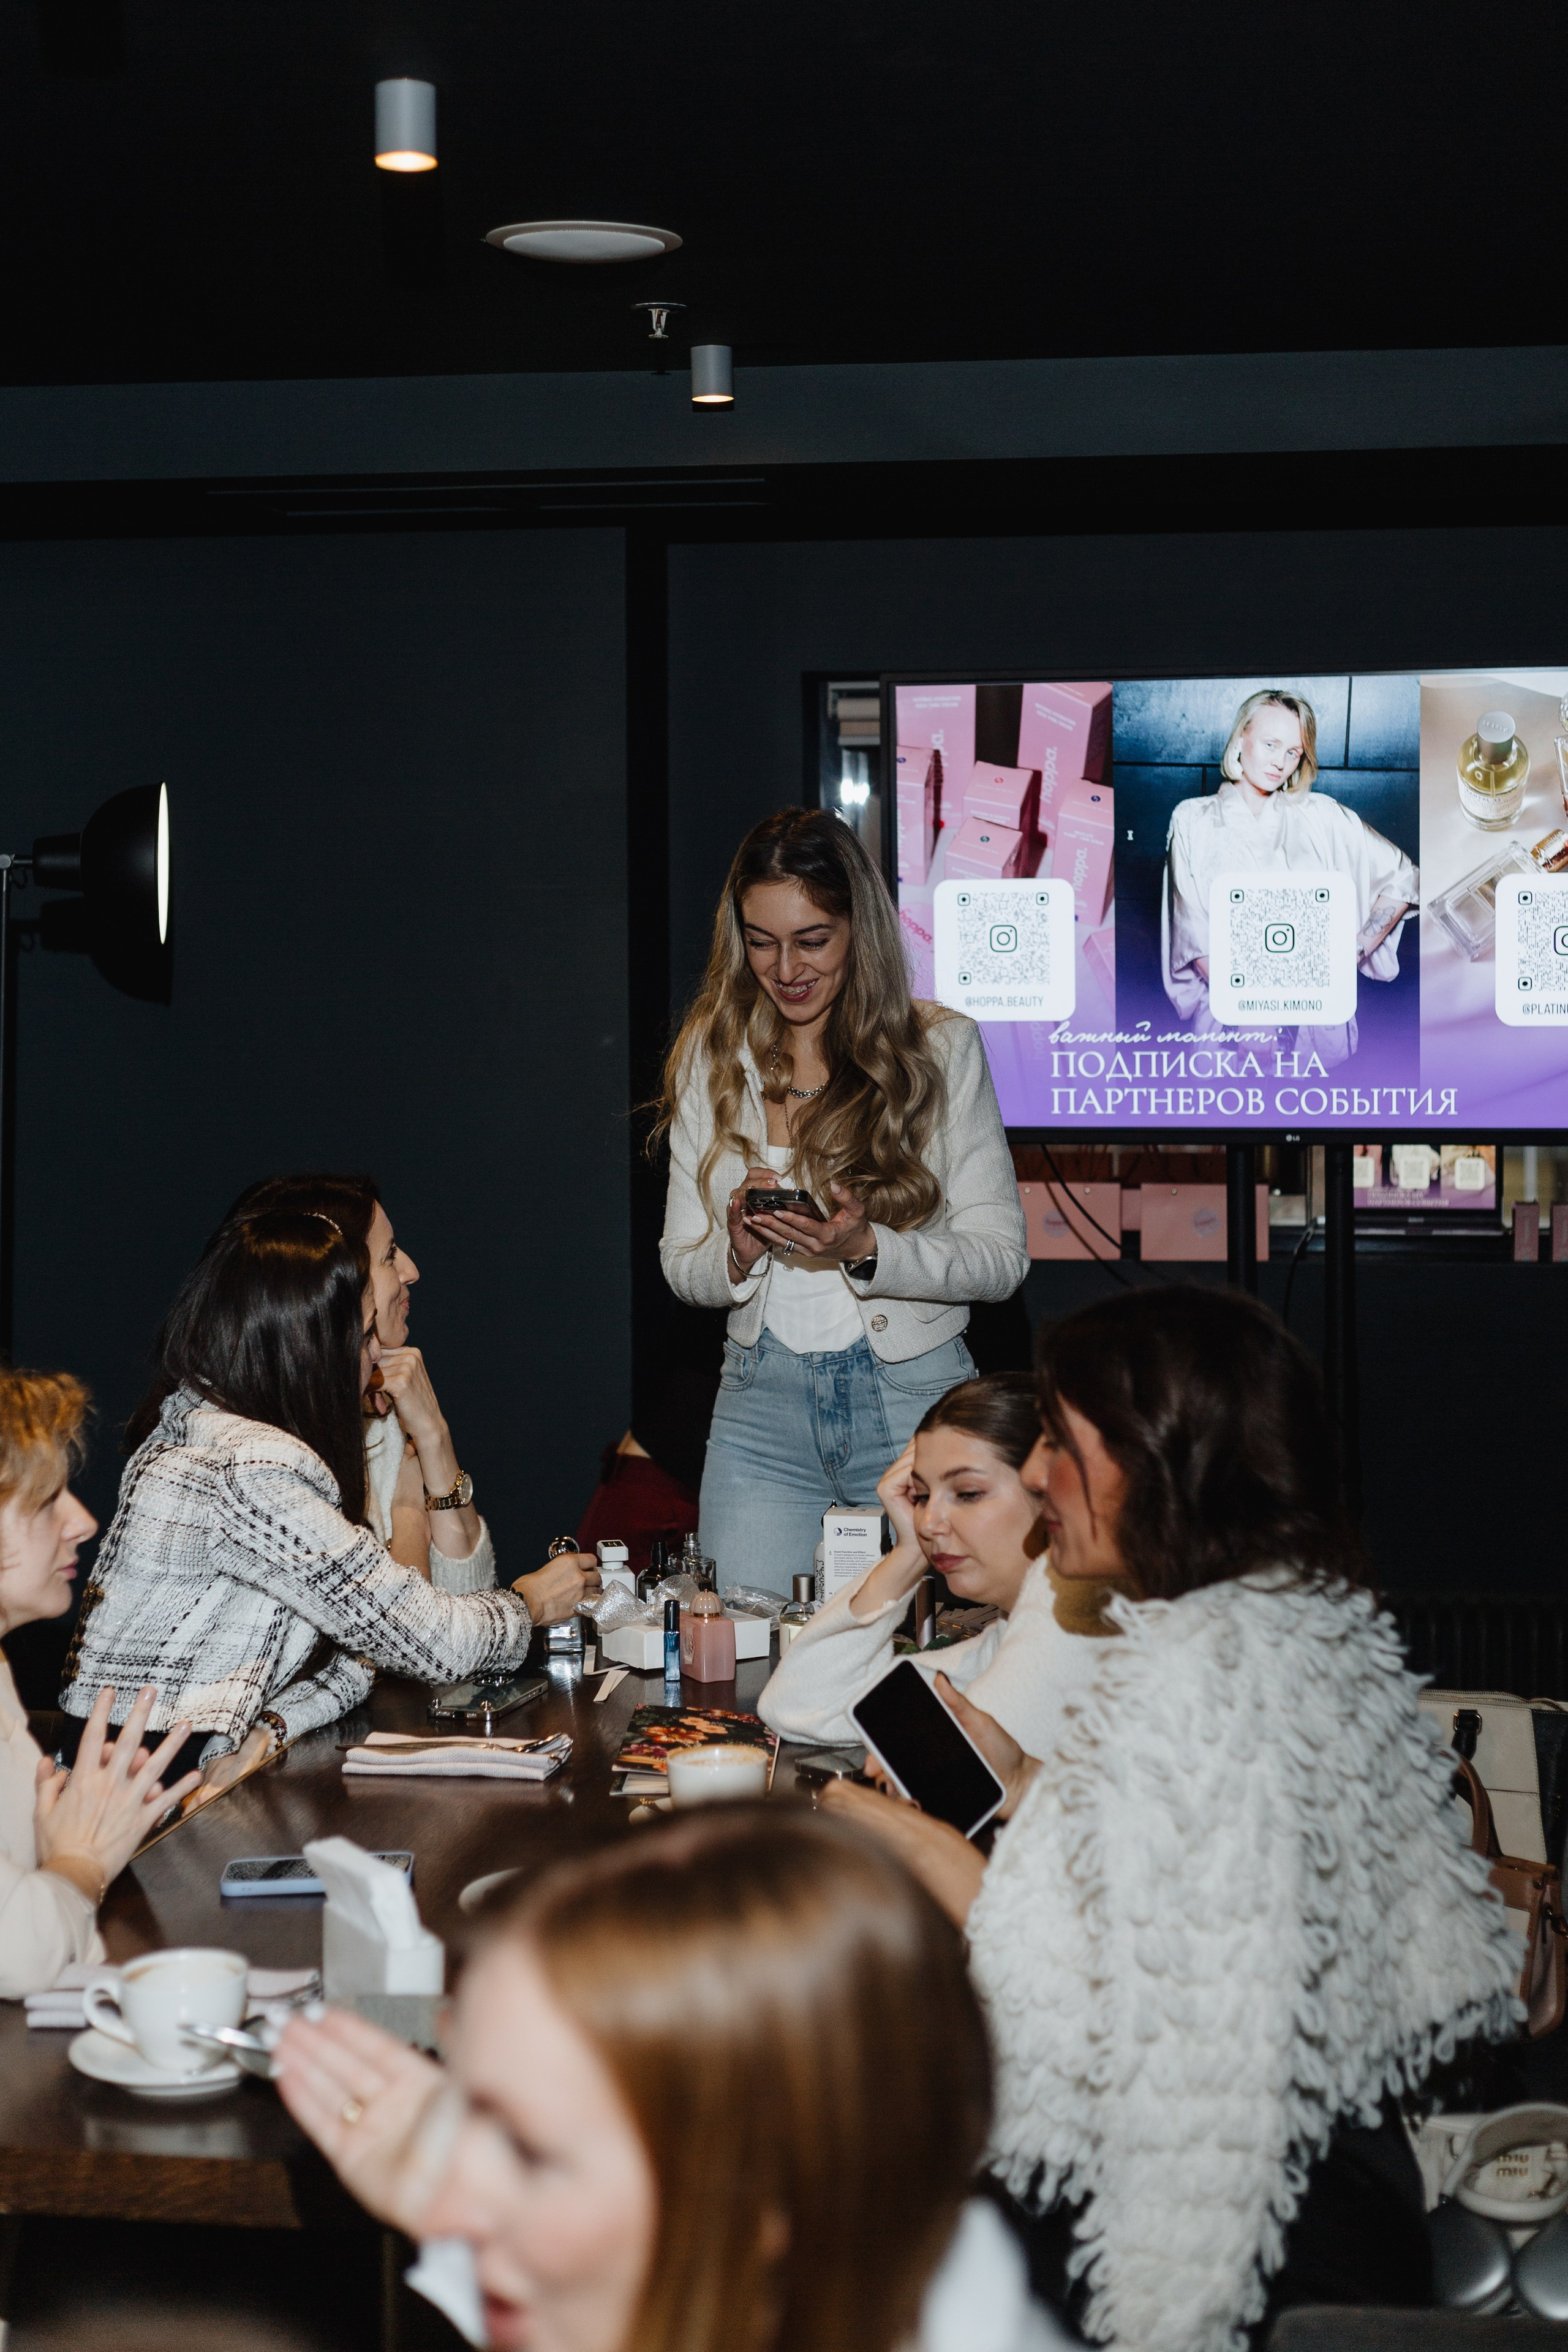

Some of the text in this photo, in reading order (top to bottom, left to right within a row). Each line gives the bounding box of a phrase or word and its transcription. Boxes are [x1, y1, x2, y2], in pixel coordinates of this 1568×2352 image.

[965, 996, 1044, 1008] @HOPPA.BEAUTY
[1238, 999, 1323, 1012] @MIYASI.KIMONO
[1522, 1003, 1568, 1015] @PLATIN
[1050, 1050, 1329, 1083] ПОДПИСКА НА
[1051, 1087, 1458, 1116] ПАРТНЕРОВ СОБЫТИЯ
